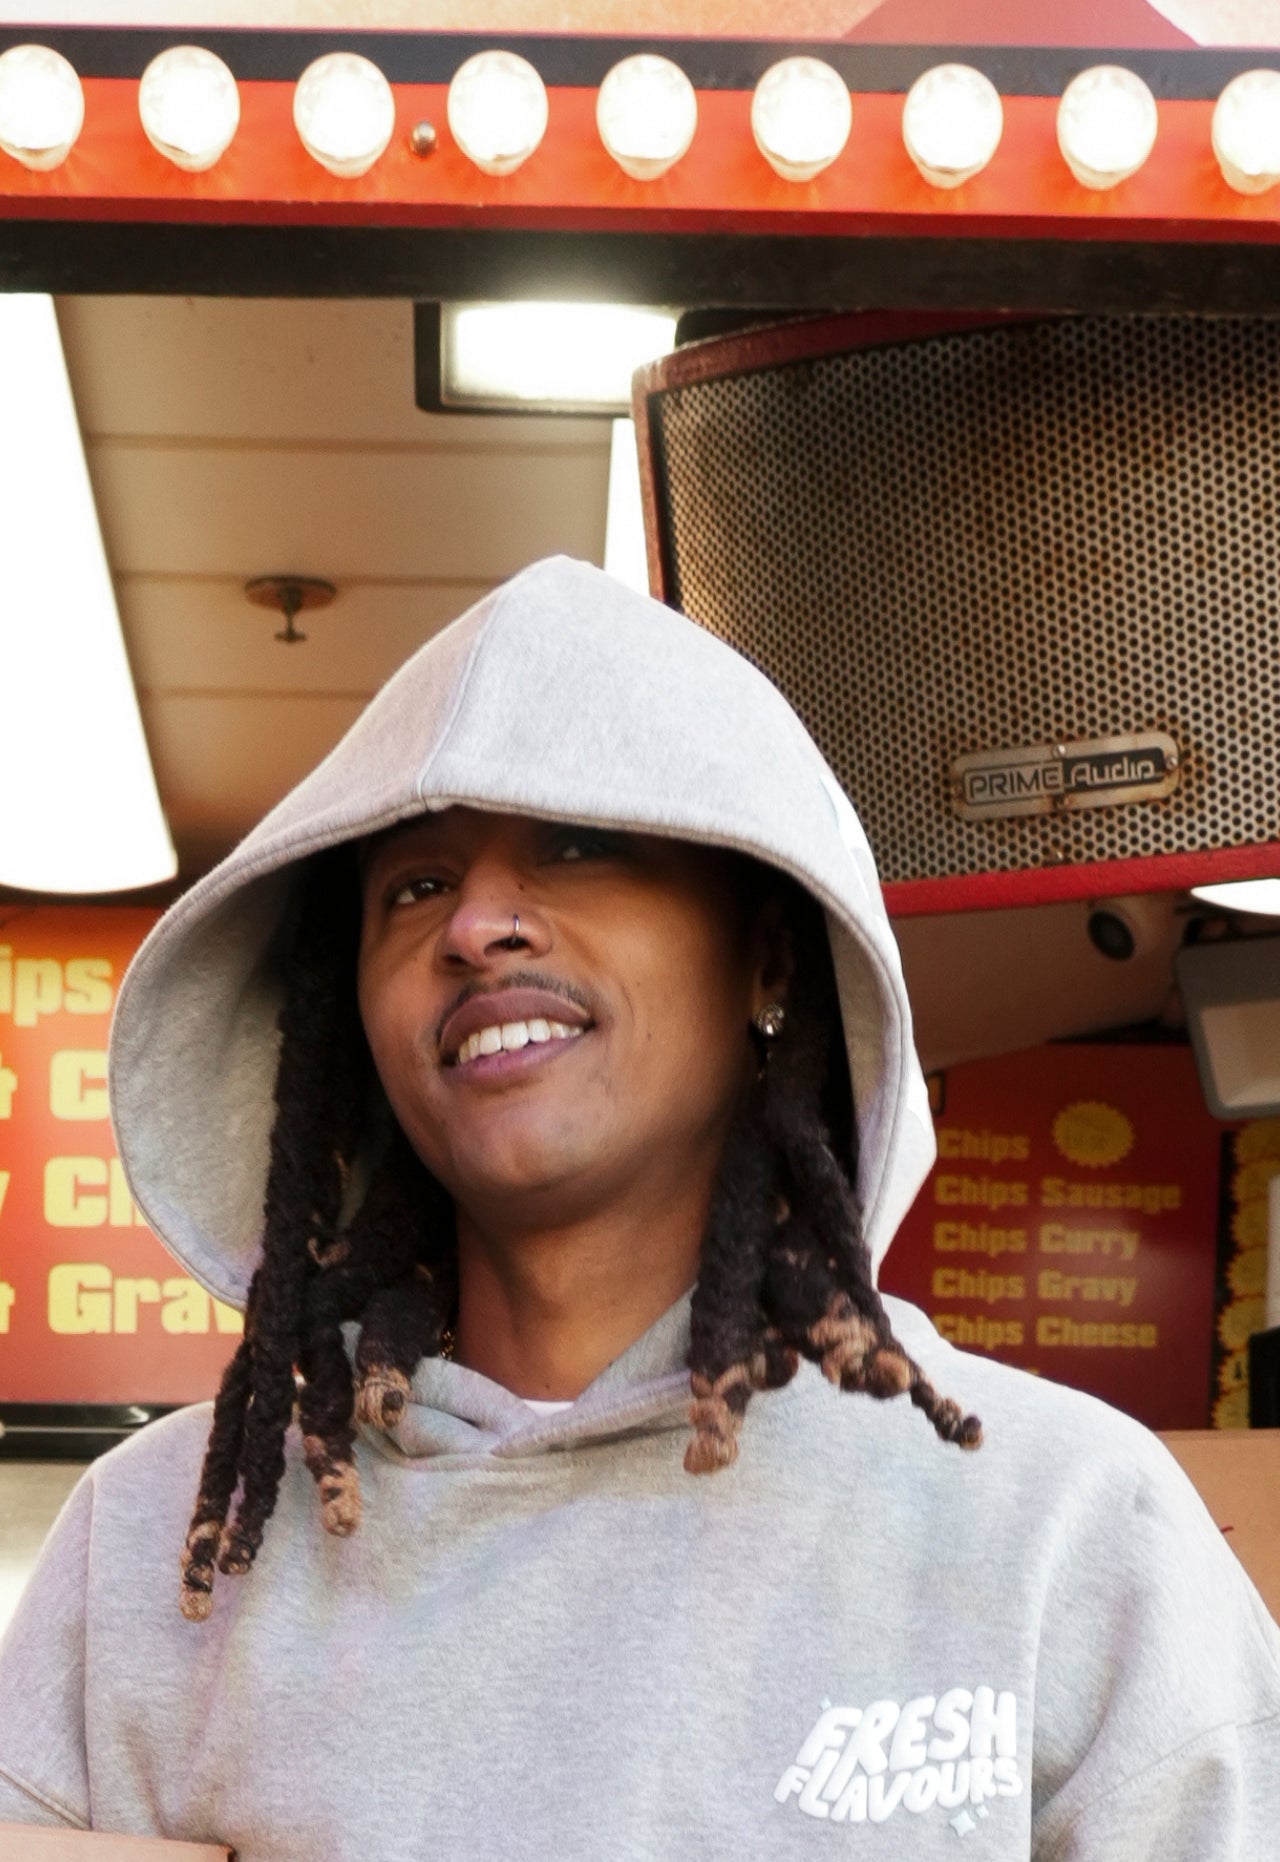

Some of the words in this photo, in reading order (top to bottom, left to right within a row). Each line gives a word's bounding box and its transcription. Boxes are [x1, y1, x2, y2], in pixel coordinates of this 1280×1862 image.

[970, 766, 1061, 799] PRIME
[937, 1129, 1030, 1165] Chips
[934, 1175, 1028, 1211] Chips
[1040, 1177, 1182, 1215] Sausage
[933, 1222, 1027, 1258] Chips
[1039, 1223, 1139, 1260] Curry
[932, 1268, 1024, 1304] Chips
[1037, 1269, 1137, 1307] Gravy
[1036, 1315, 1158, 1348] Cheese
[795, 1685, 1017, 1801] FRESH
[773, 1750, 1023, 1823] FLAVOURS
